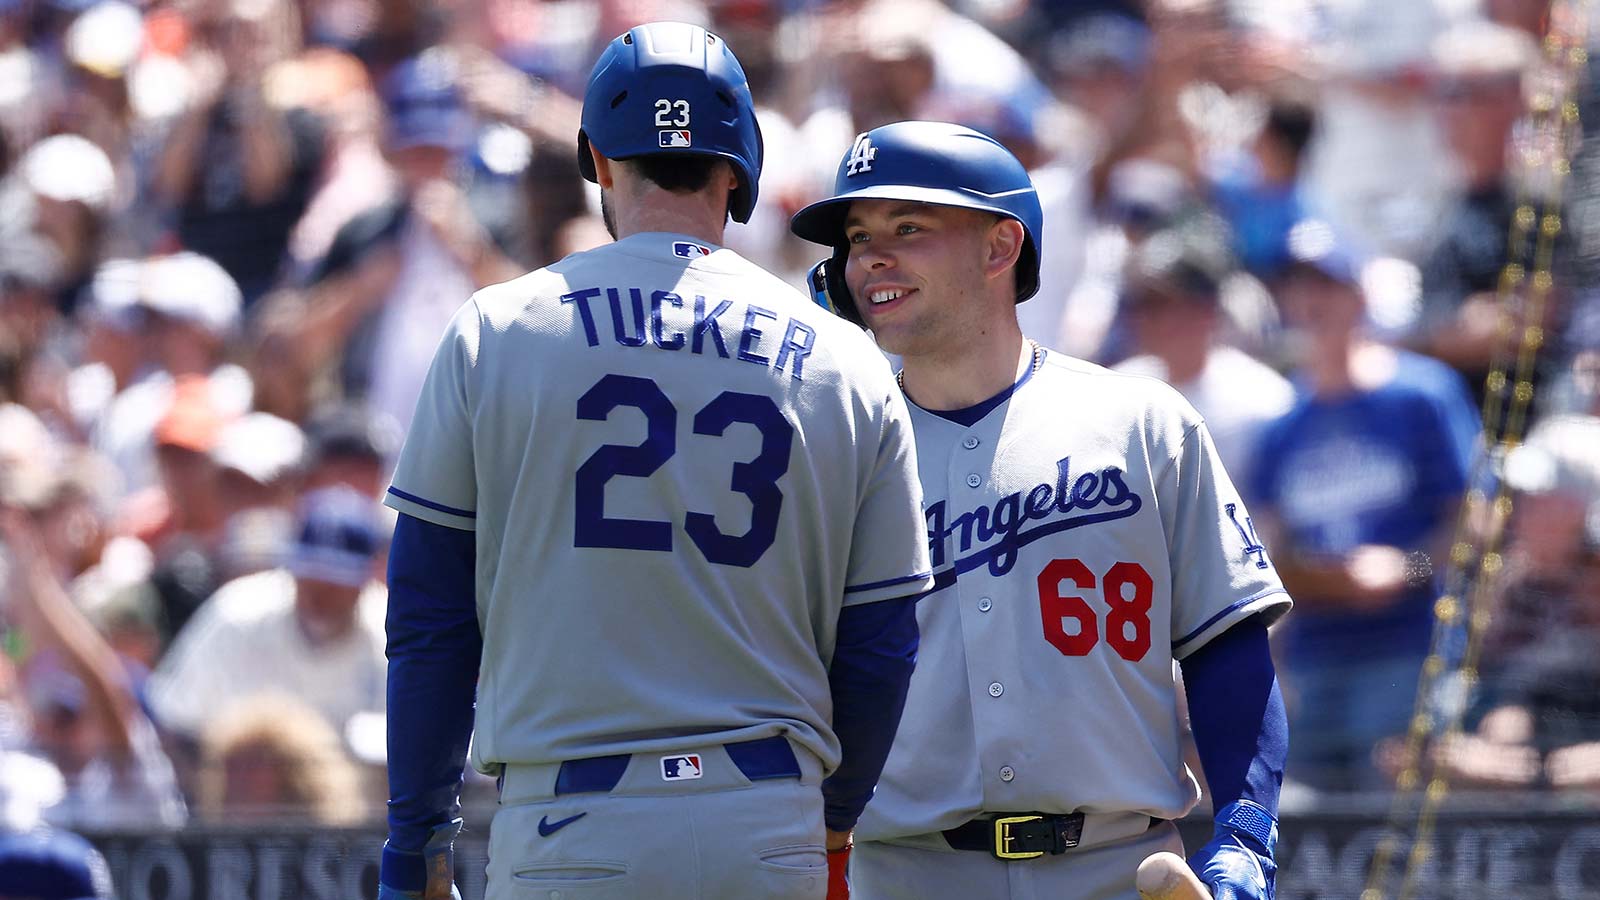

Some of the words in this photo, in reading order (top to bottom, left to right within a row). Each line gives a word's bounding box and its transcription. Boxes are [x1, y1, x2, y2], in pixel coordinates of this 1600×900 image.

[654, 99, 690, 128] 23
[846, 132, 878, 177] LA
[560, 287, 816, 381] TUCKER
[574, 373, 794, 568] 23
[924, 455, 1142, 577] Angeles
[1037, 558, 1154, 663] 68
